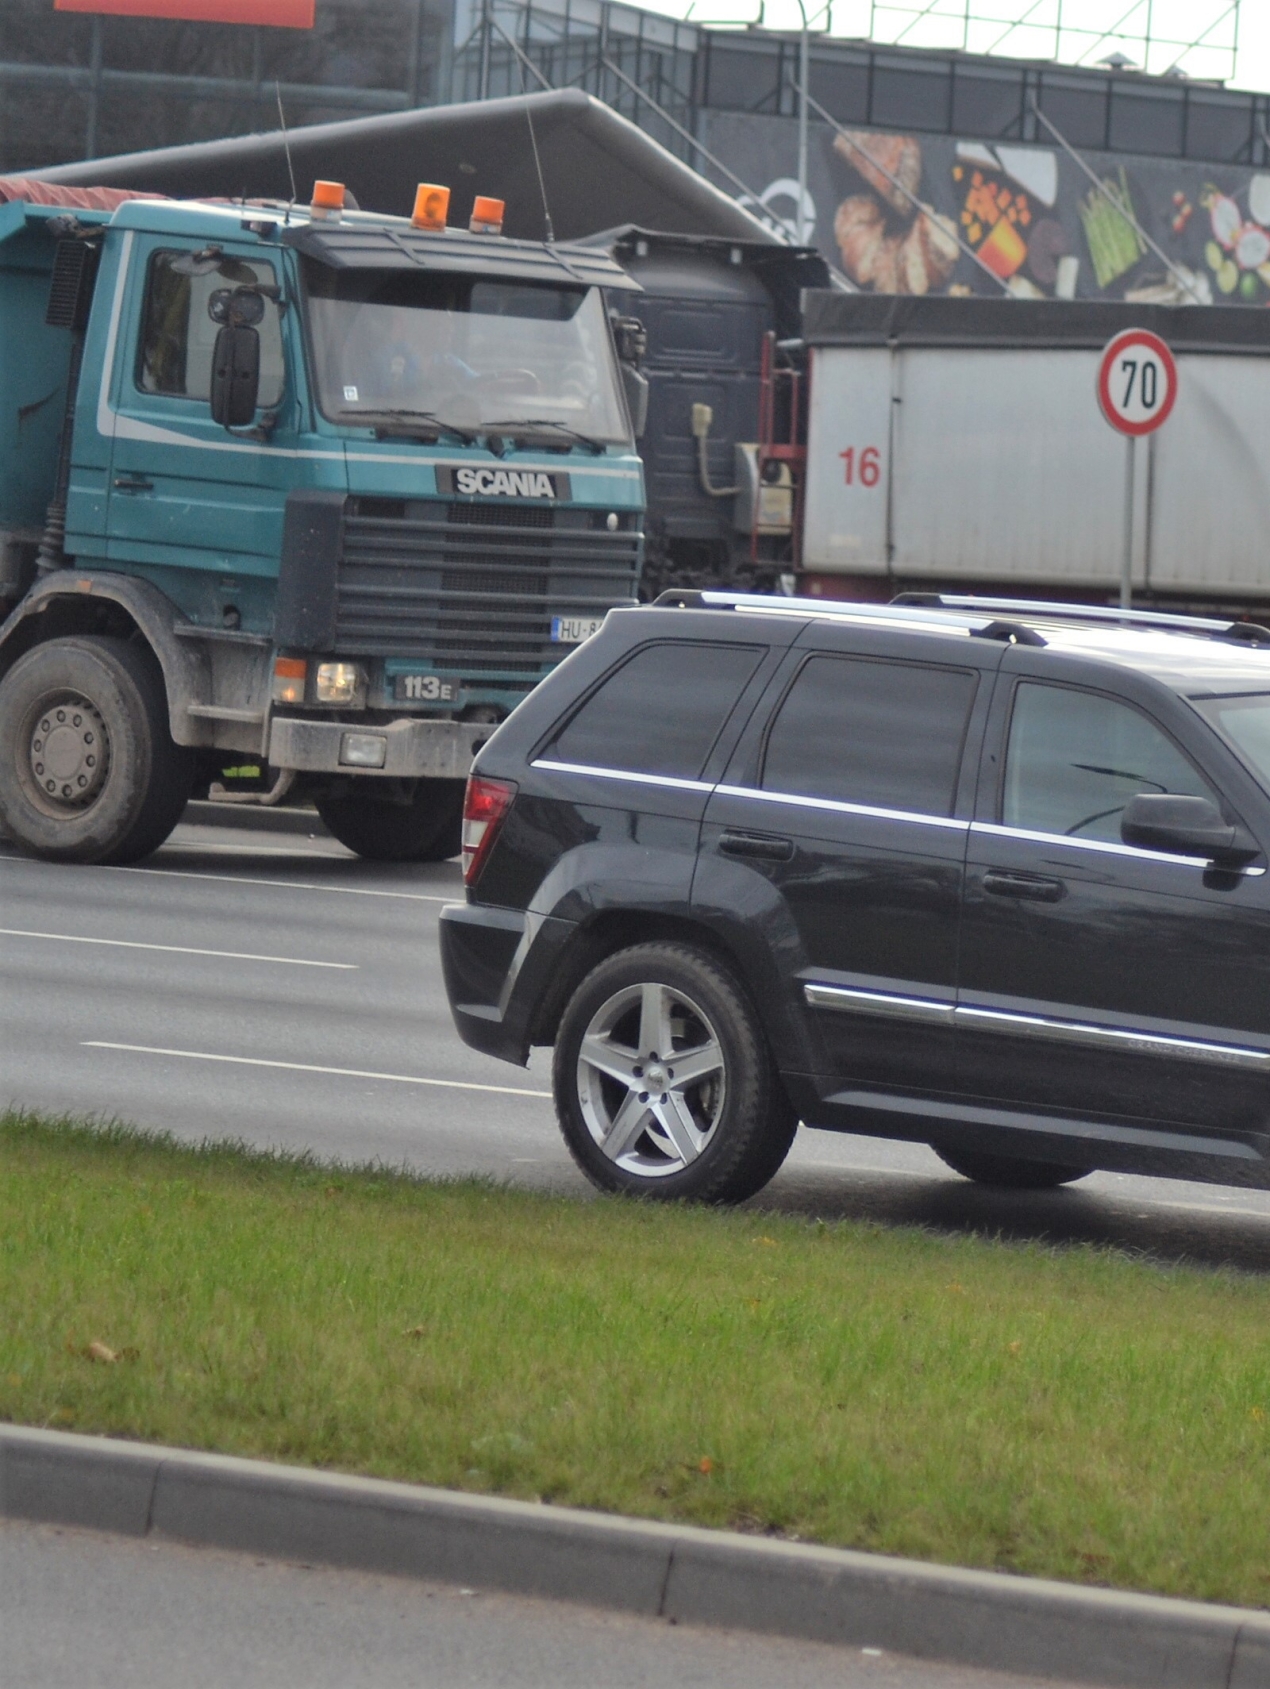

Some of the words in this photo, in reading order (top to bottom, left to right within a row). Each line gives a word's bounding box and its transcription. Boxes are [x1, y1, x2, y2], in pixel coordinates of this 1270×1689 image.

[1122, 361, 1156, 409] 70
[457, 469, 554, 498] SCANIA
[839, 446, 880, 487] 16
